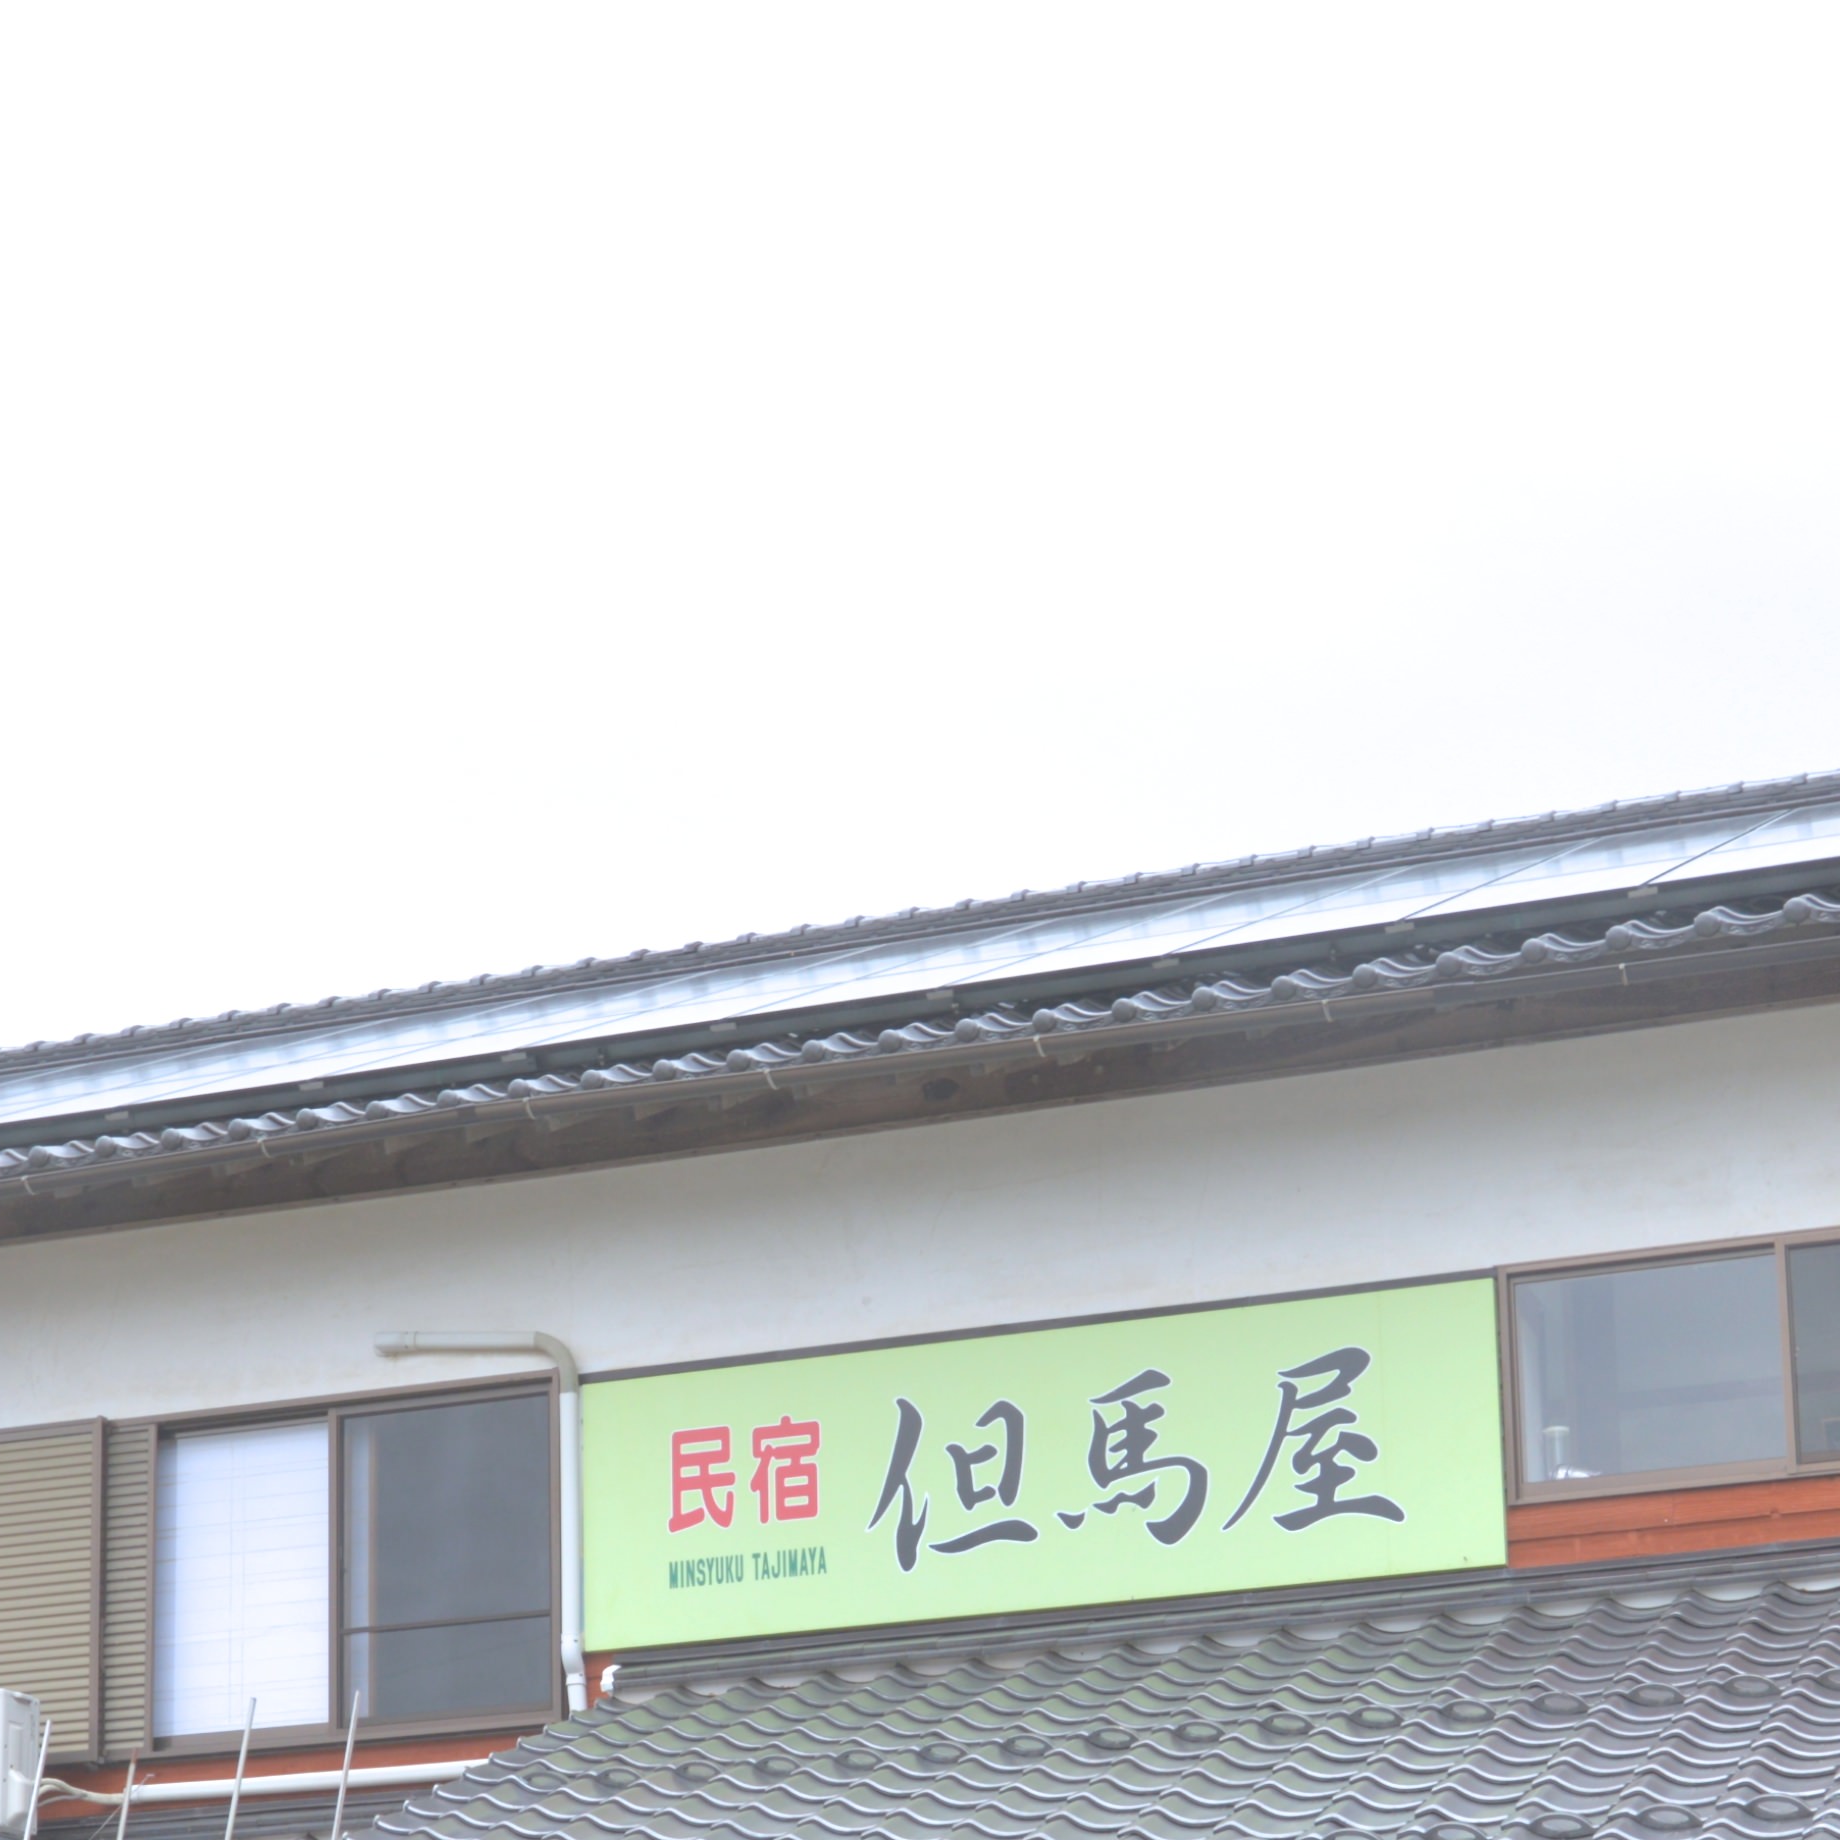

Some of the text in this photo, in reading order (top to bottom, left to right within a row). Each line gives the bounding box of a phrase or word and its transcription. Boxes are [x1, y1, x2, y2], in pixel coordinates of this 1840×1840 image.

[667, 1345, 1407, 1574] 民宿 但馬屋
[668, 1545, 828, 1589] MINSYUKU TAJIMAYA
